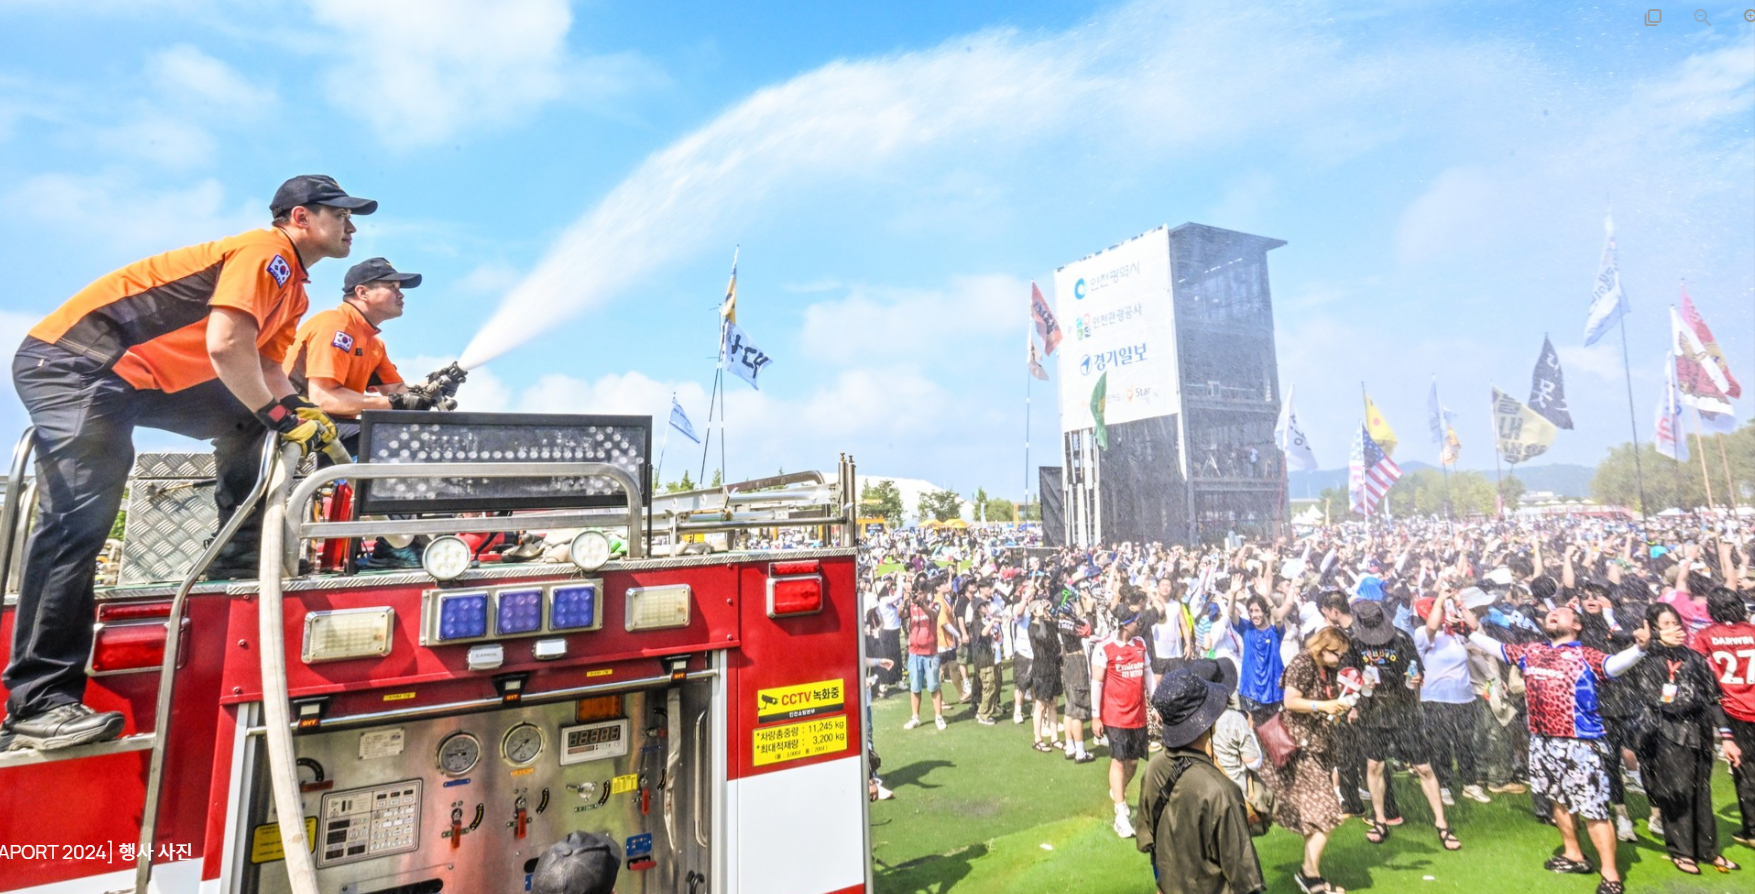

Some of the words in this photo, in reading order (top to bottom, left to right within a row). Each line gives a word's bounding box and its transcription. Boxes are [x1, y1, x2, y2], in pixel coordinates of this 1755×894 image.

[1090, 260, 1140, 292] 인천광역시
[1092, 303, 1142, 329] 인천관광공사
[1094, 343, 1147, 371] 경기일보
[1135, 386, 1151, 397] Star
[1711, 635, 1754, 646] DARWIN
[1712, 648, 1755, 685] 27
[781, 691, 812, 706] CCTV
[813, 686, 839, 700] 녹화중
[302, 719, 317, 727] GVT
[808, 722, 833, 734] 11,245
[835, 721, 844, 731] kg
[813, 734, 833, 745] 3,200
[835, 732, 845, 741] kg
